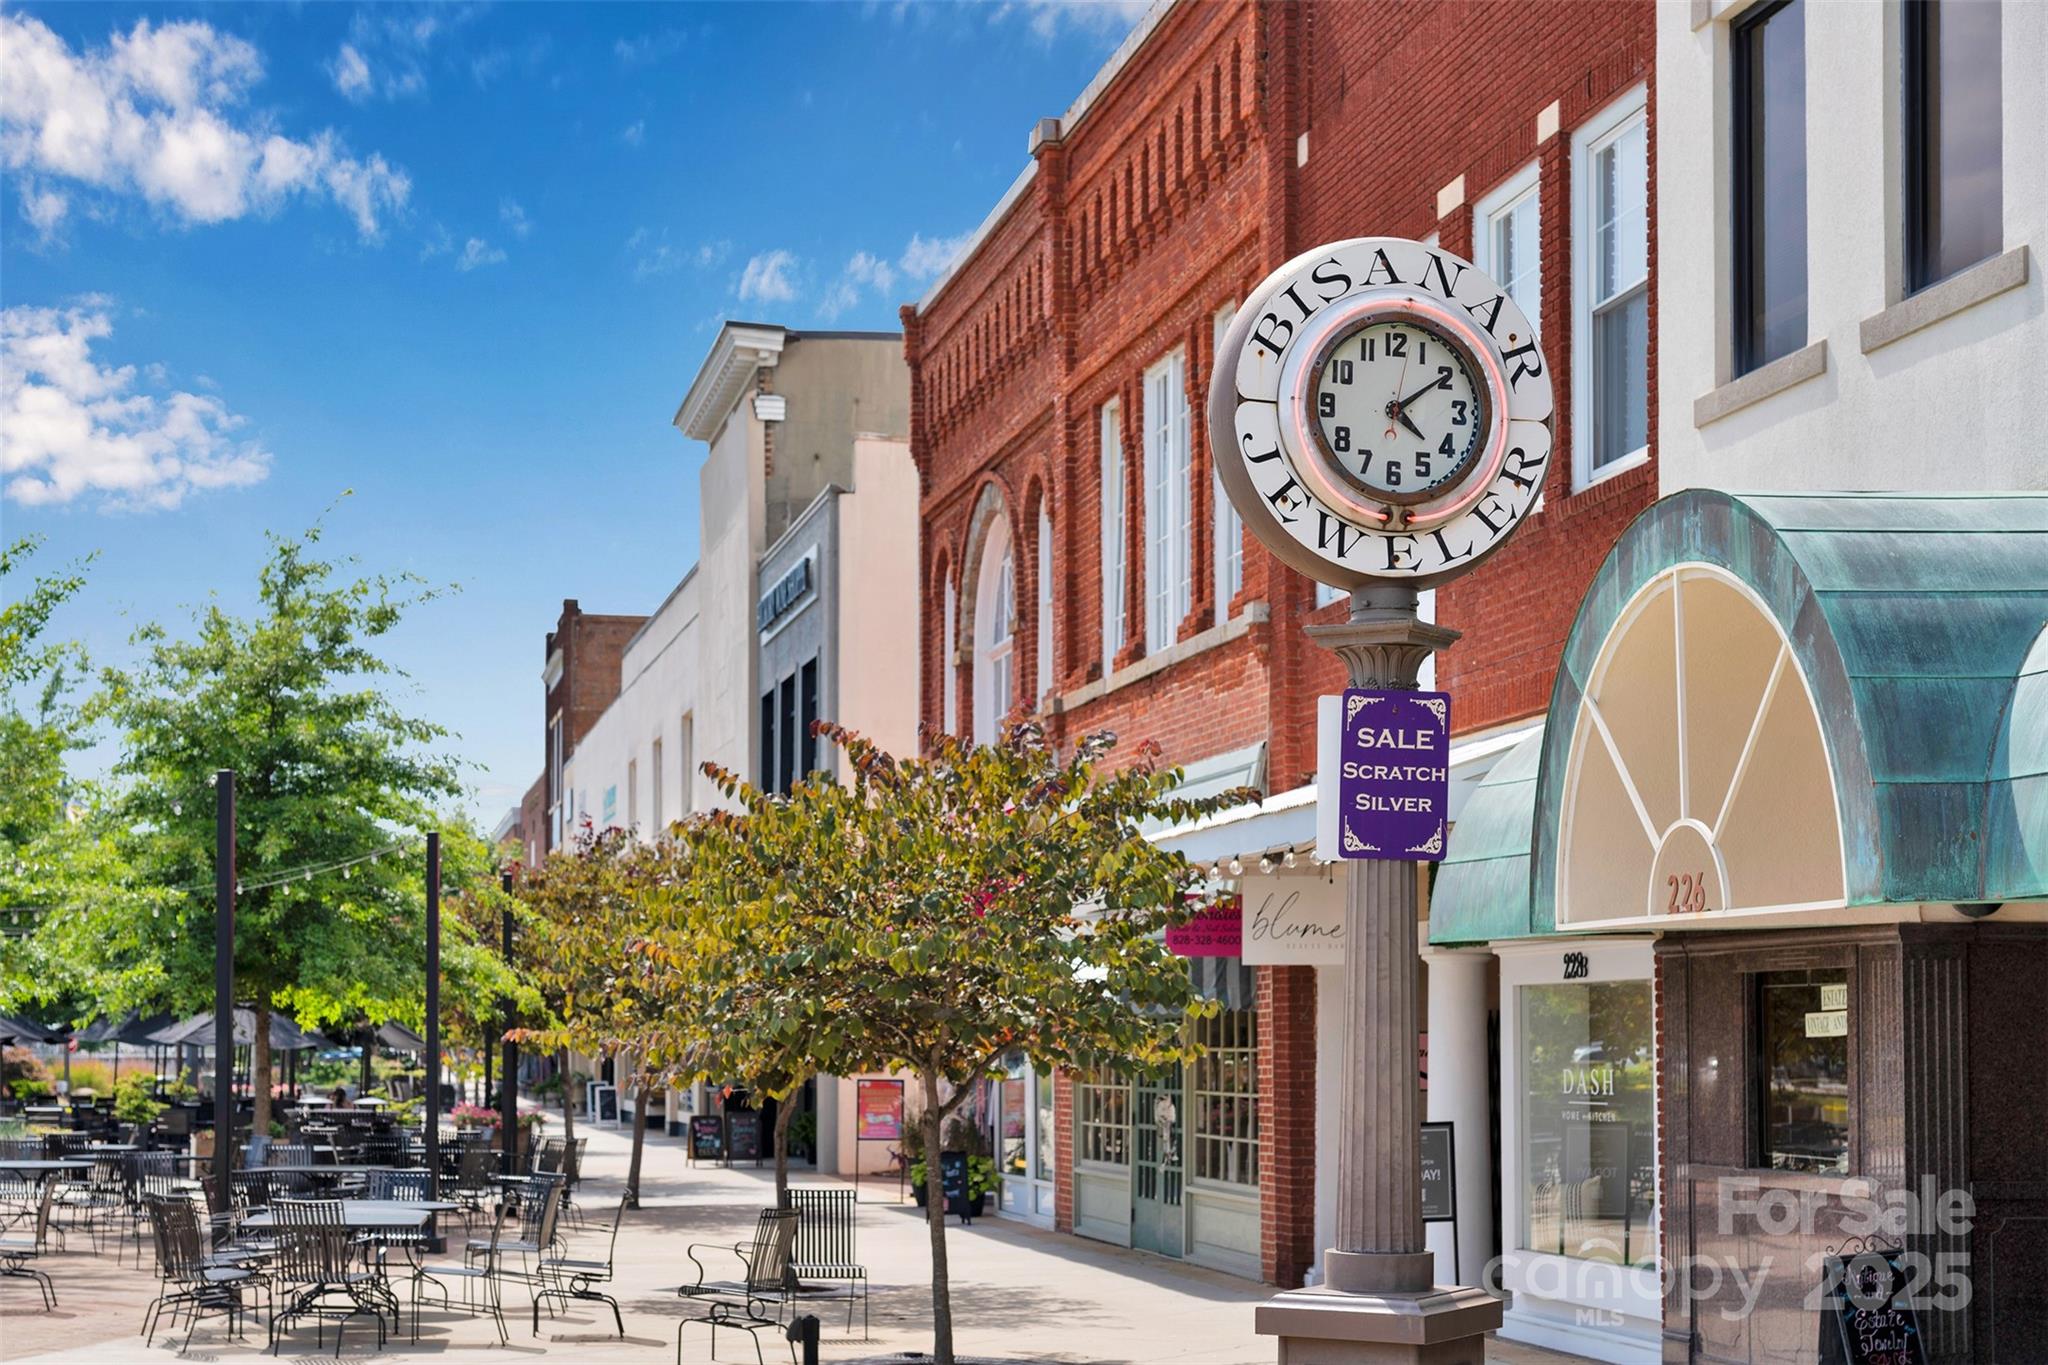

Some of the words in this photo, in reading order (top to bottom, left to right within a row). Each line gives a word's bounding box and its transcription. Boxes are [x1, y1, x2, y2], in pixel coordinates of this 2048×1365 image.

[1248, 248, 1542, 394] BISANAR
[1361, 338, 1375, 362] 11
[1385, 332, 1407, 358] 12
[1332, 359, 1353, 385] 10
[1437, 366, 1453, 390] 2
[1320, 392, 1336, 418] 9
[1451, 400, 1467, 426] 3
[1334, 426, 1351, 452] 8
[1438, 432, 1455, 458] 4
[1358, 449, 1373, 475] 7
[1386, 460, 1402, 486] 6
[1415, 451, 1431, 477] 5
[1242, 432, 1548, 573] JEWELER
[1357, 727, 1434, 750] SALE
[1667, 872, 1706, 913] 226
[1251, 890, 1346, 941] blume
[1562, 1068, 1615, 1096] DASH
